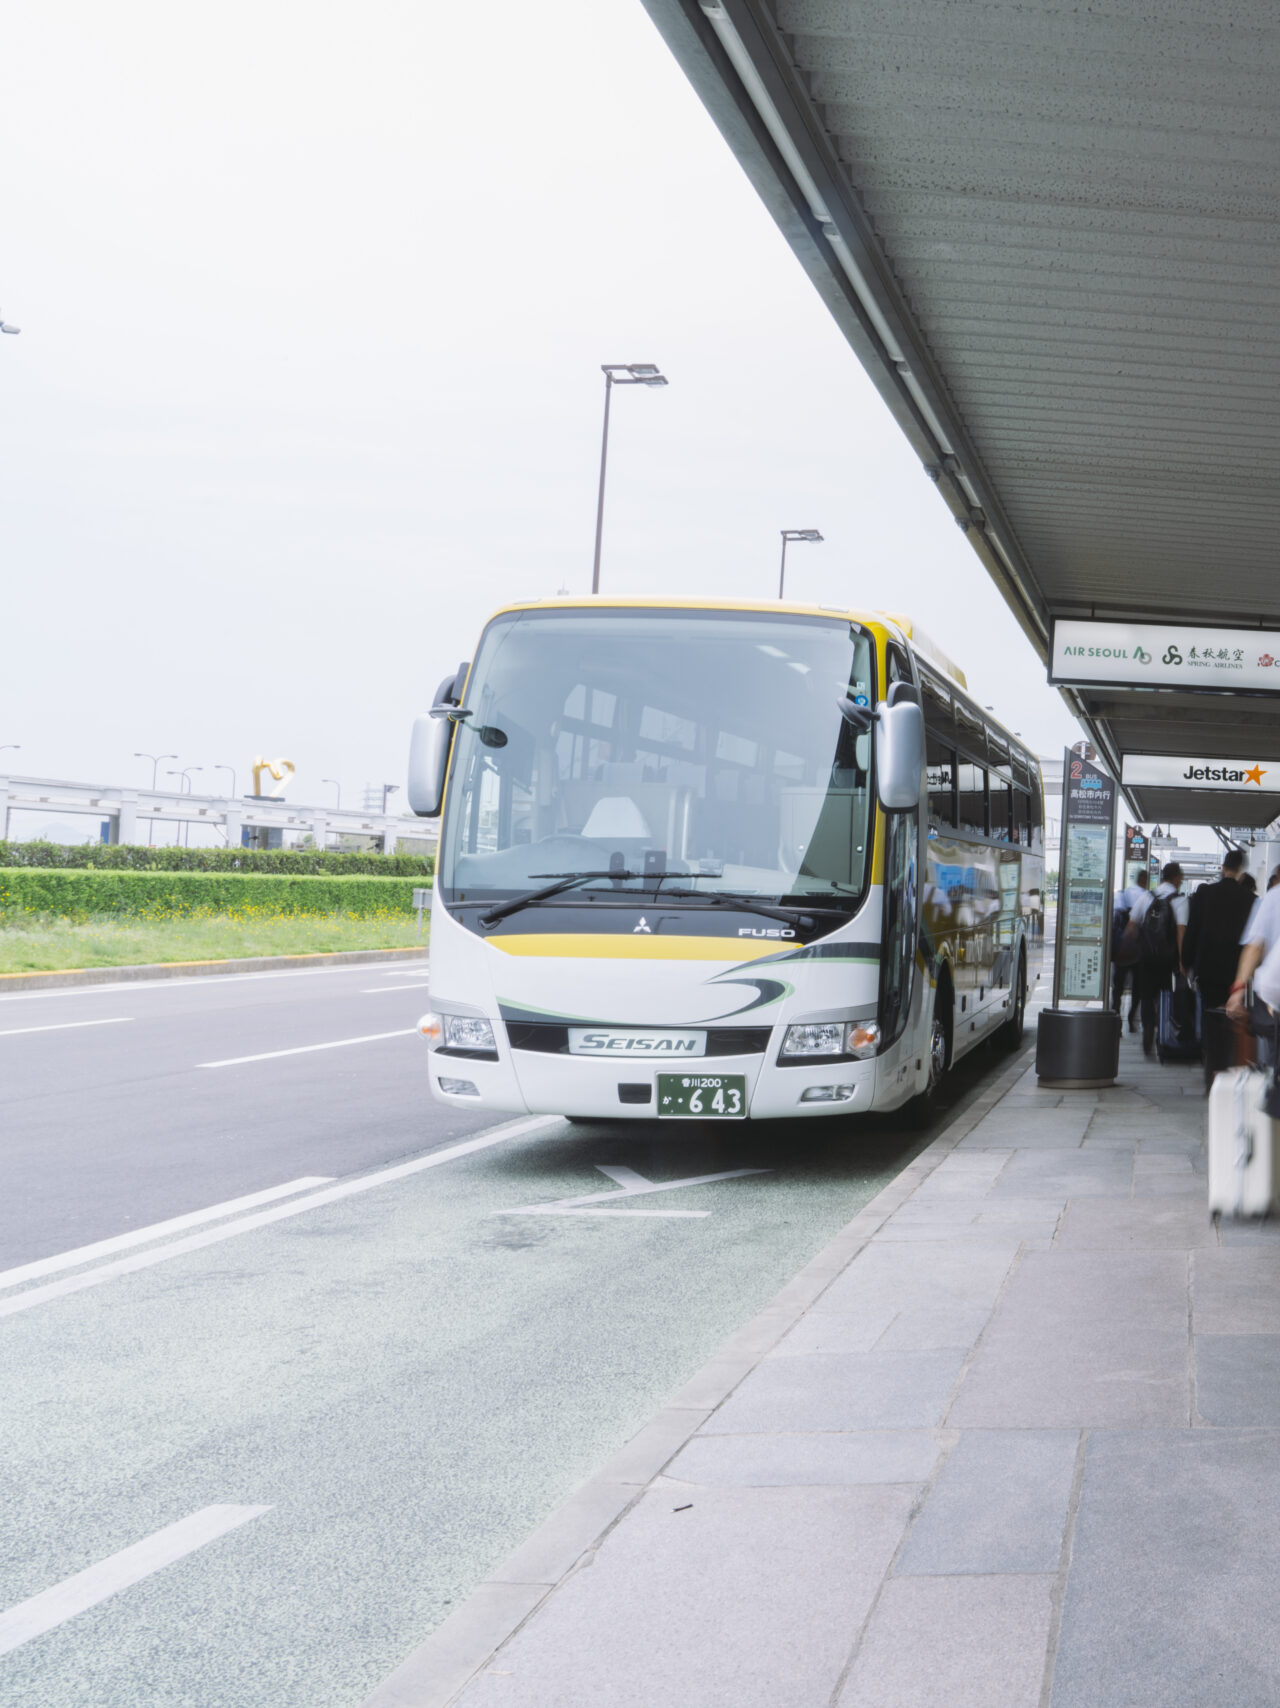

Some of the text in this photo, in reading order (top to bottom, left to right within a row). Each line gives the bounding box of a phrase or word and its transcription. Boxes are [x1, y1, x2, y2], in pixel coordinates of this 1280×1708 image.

[1064, 646, 1128, 659] AIR SEOUL
[1070, 761, 1082, 779] 2
[1183, 765, 1245, 782] Jetstar
[738, 928, 796, 938] FUSO
[578, 1034, 697, 1051] SEISAN
